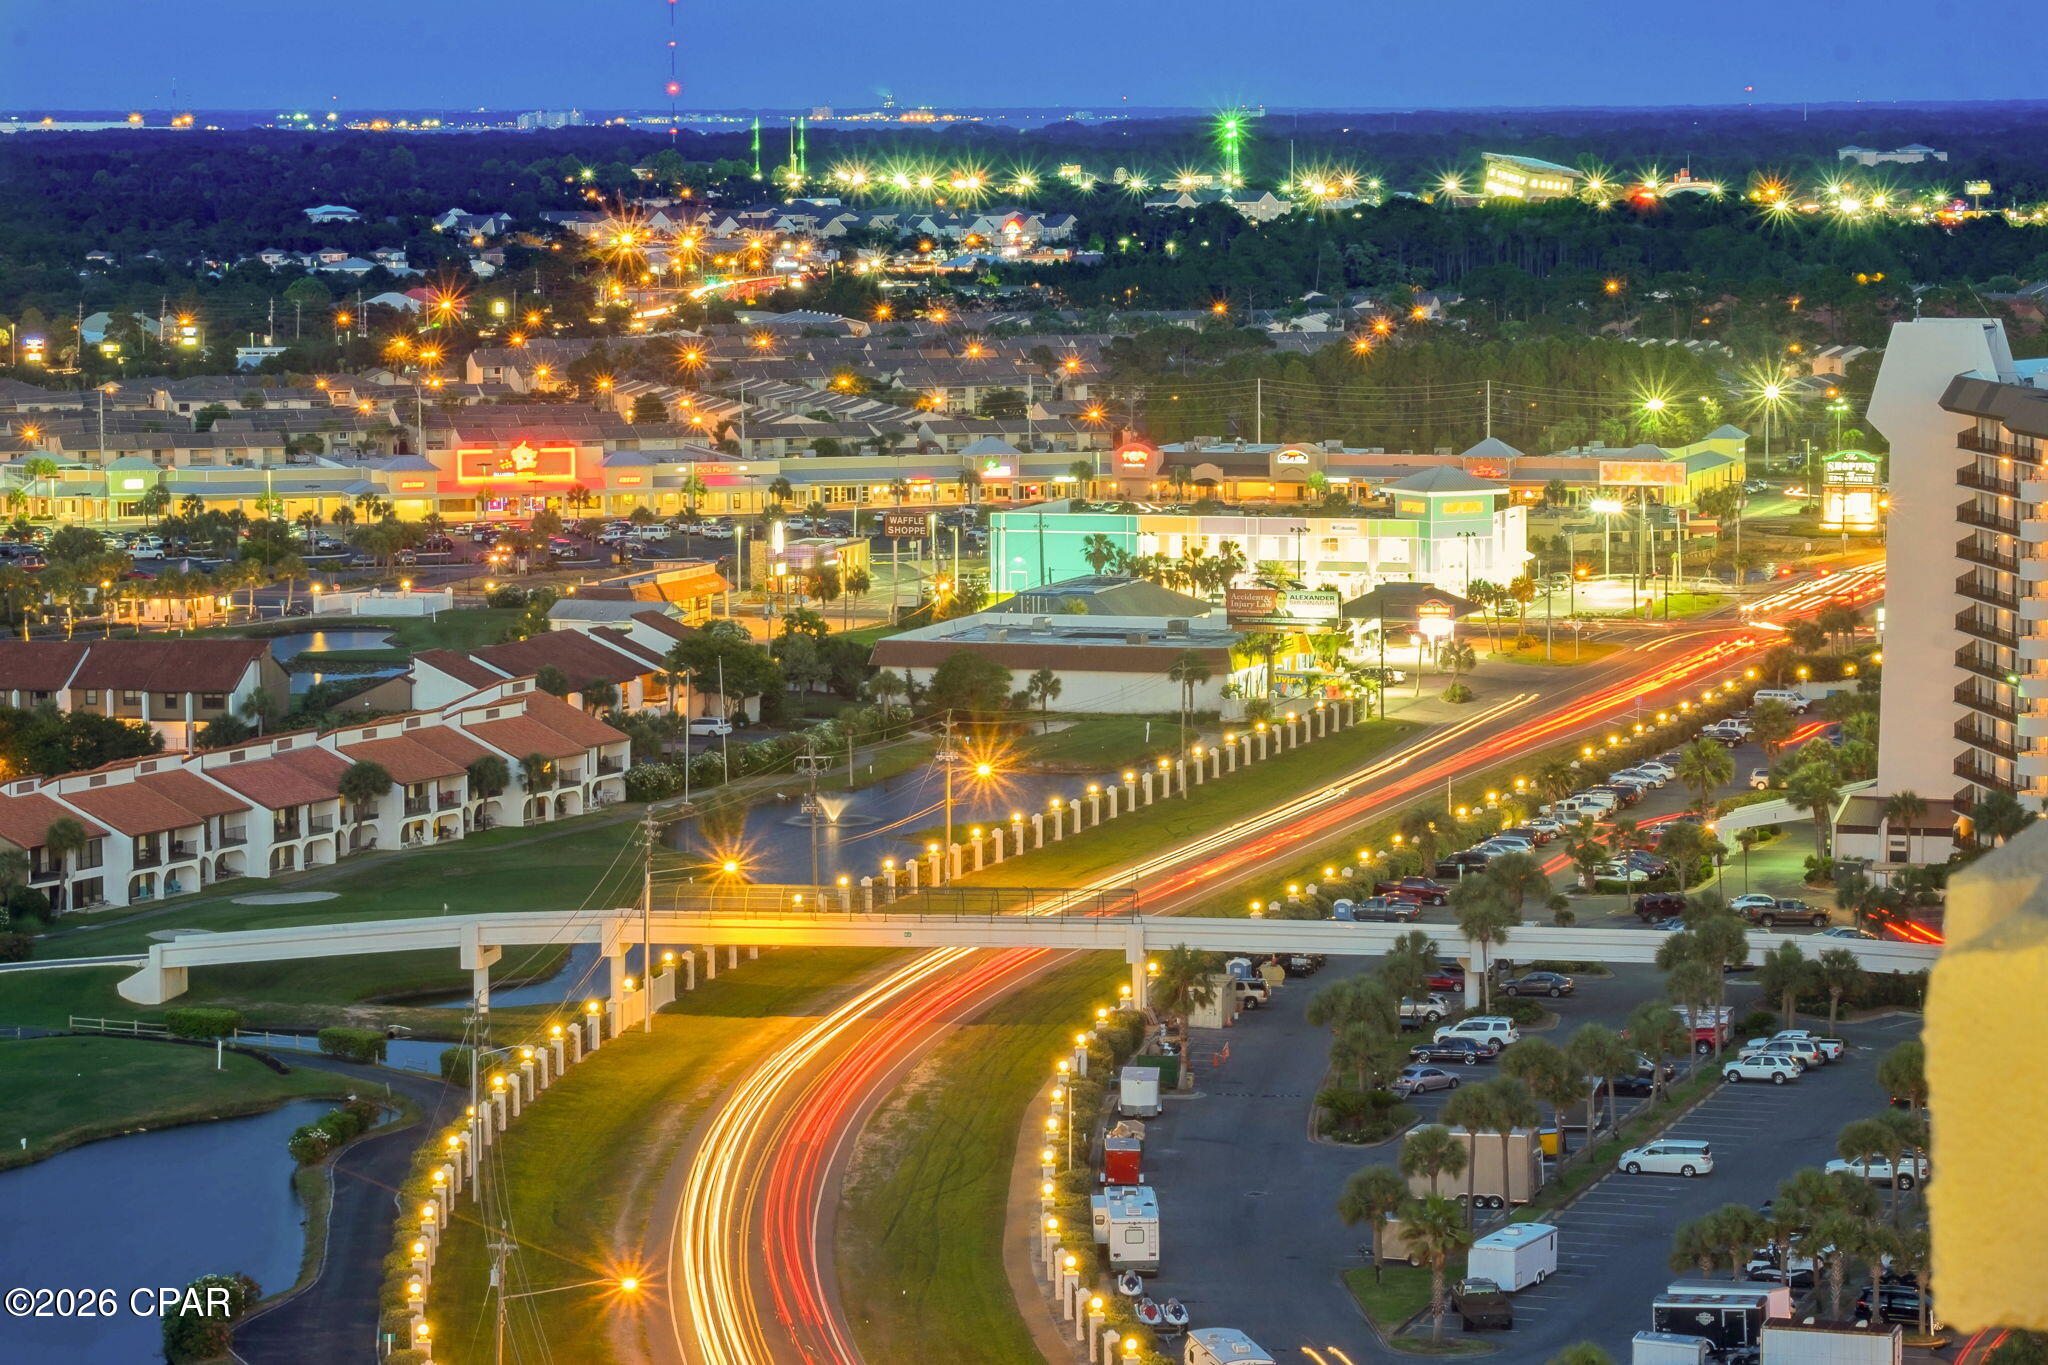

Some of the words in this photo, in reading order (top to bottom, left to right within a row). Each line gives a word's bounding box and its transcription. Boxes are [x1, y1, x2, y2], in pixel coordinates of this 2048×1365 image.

[889, 516, 925, 525] WAFFLE
[888, 526, 926, 535] SHOPPE
[1231, 600, 1254, 608] Injury
